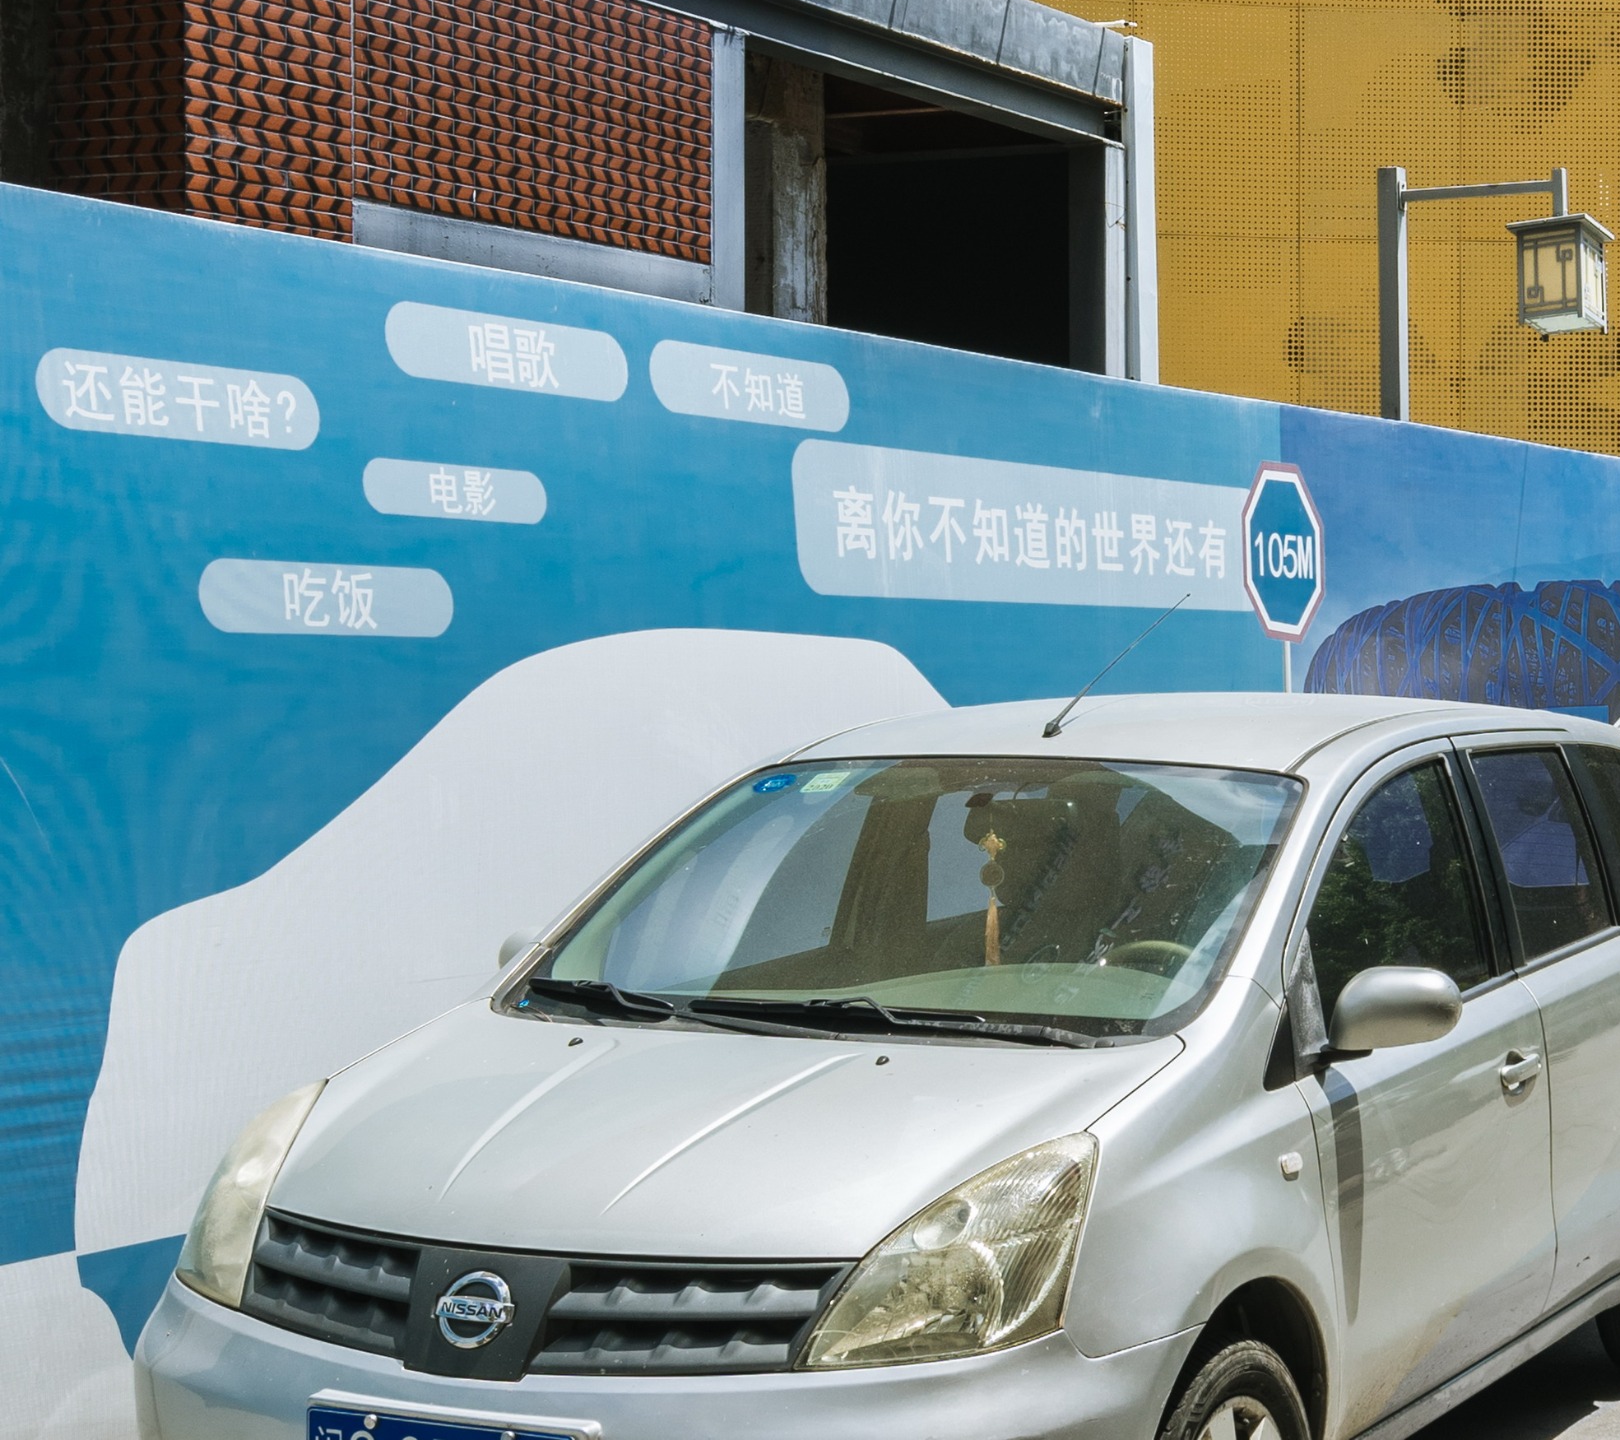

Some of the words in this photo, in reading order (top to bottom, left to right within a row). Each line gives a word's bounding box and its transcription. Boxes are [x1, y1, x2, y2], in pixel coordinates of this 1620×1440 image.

[468, 321, 561, 389] 唱歌
[62, 360, 298, 441] 还能干啥?
[708, 362, 807, 421] 不知道
[428, 465, 498, 519] 电影
[832, 485, 1227, 580] 离你不知道的世界还有
[1254, 531, 1314, 580] 105M
[282, 569, 379, 630] 吃饭
[441, 1301, 503, 1319] NISSAN
